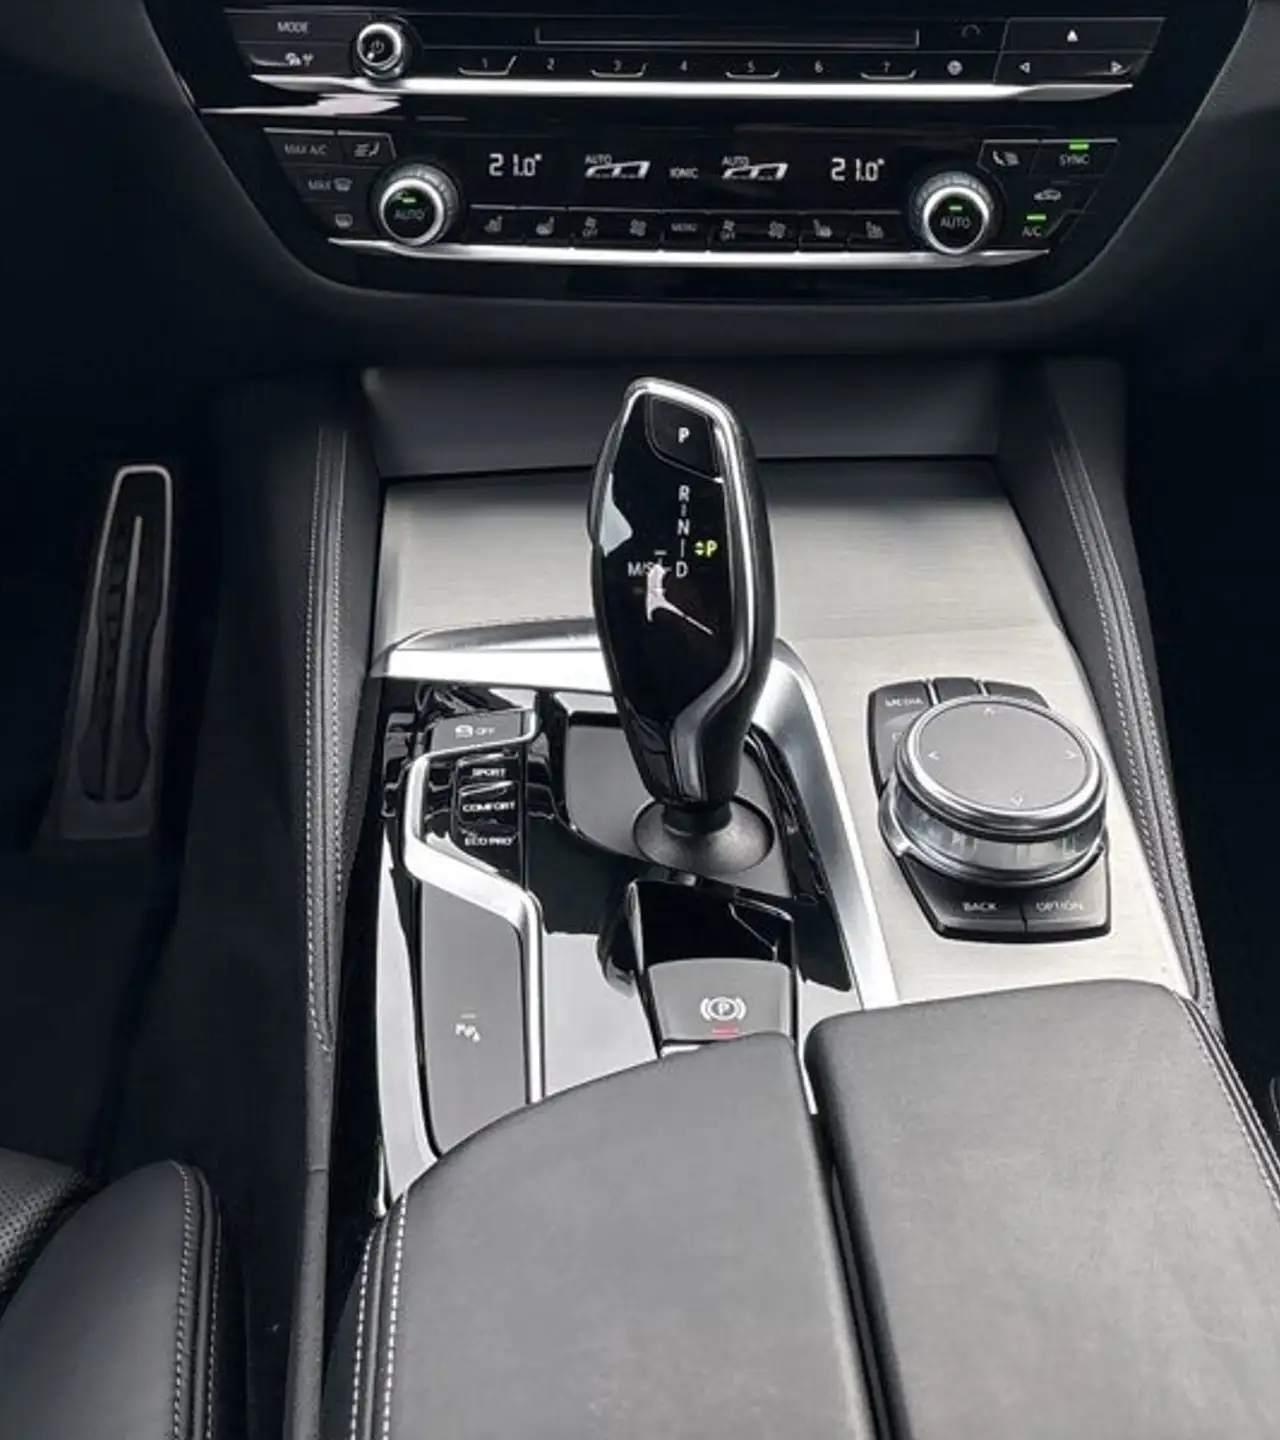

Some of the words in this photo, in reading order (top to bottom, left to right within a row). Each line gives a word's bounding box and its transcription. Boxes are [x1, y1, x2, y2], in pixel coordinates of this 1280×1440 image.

[277, 21, 308, 35] MODE
[585, 154, 612, 164] AUTO
[722, 156, 749, 166] AUTO
[1060, 153, 1090, 165] SYNC
[670, 167, 699, 179] IONIC
[395, 210, 424, 220] AUTO
[941, 216, 971, 229] AUTO
[1022, 226, 1042, 237] A/C
[678, 428, 690, 443] P
[678, 485, 690, 502] R
[677, 518, 690, 536] N
[676, 561, 689, 579] D
[475, 726, 495, 736] OFF
[472, 768, 506, 777] SPORT
[462, 801, 516, 813] COMFORT
[464, 837, 488, 846] ECO
[489, 837, 513, 846] PRO
[962, 901, 997, 911] BACK
[1036, 901, 1083, 911] OPTION
